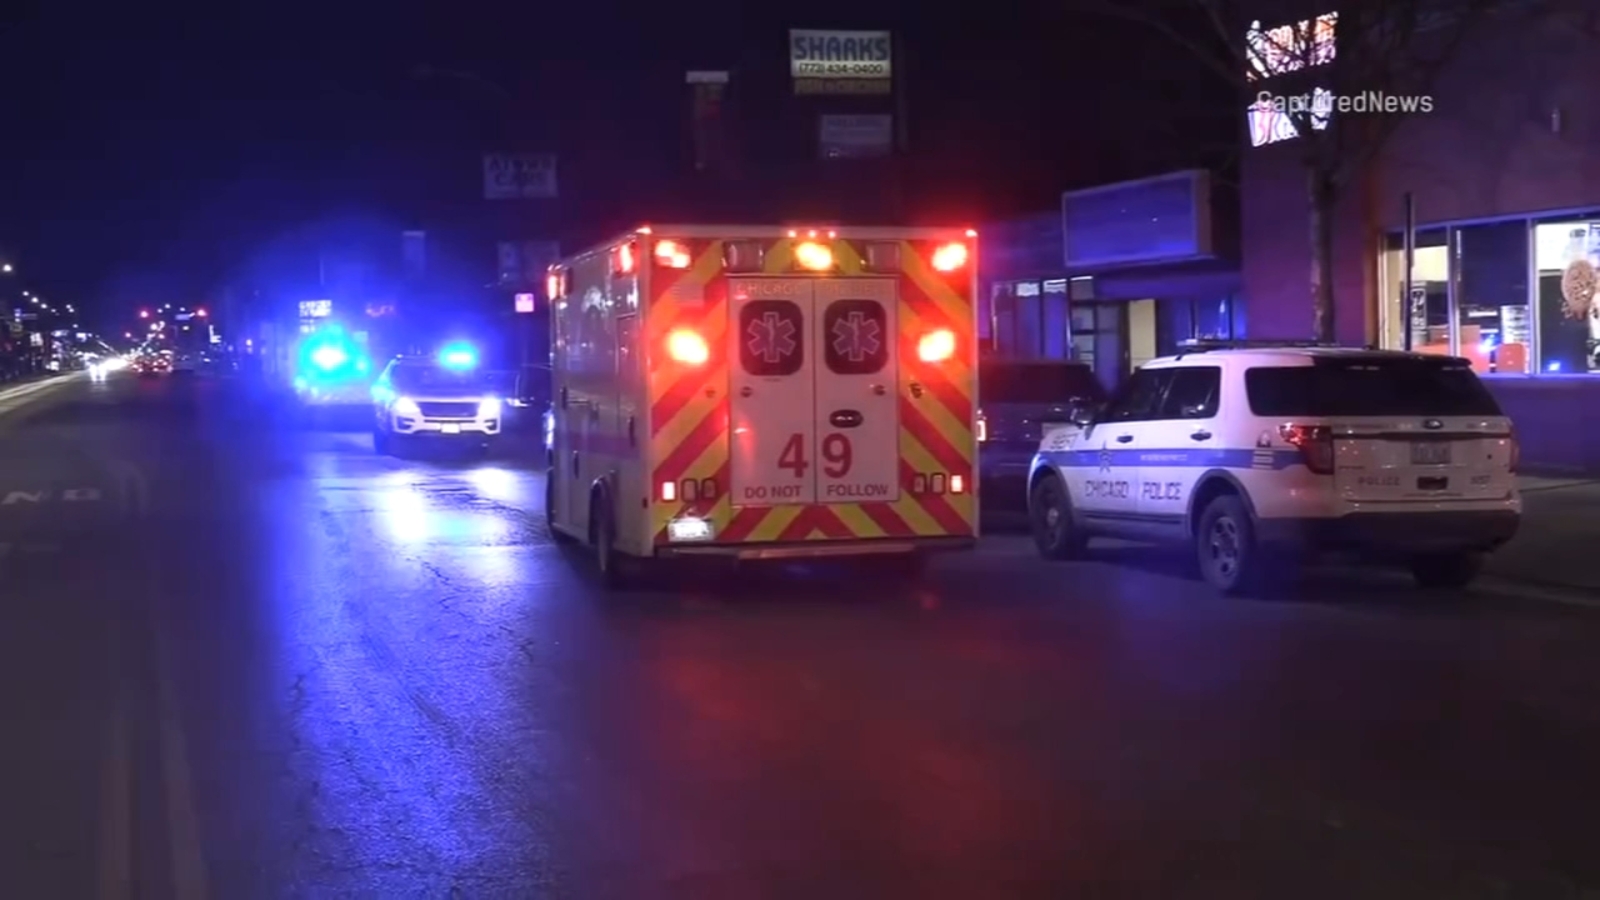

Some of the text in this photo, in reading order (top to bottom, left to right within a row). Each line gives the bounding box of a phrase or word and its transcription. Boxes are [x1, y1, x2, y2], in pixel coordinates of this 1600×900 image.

[793, 35, 888, 62] SHARKS
[826, 63, 884, 75] 434-0400
[1357, 475, 1400, 486] POLICE
[744, 484, 889, 498] DO NOT FOLLOW
[1085, 480, 1183, 501] CHICAGO POLICE
